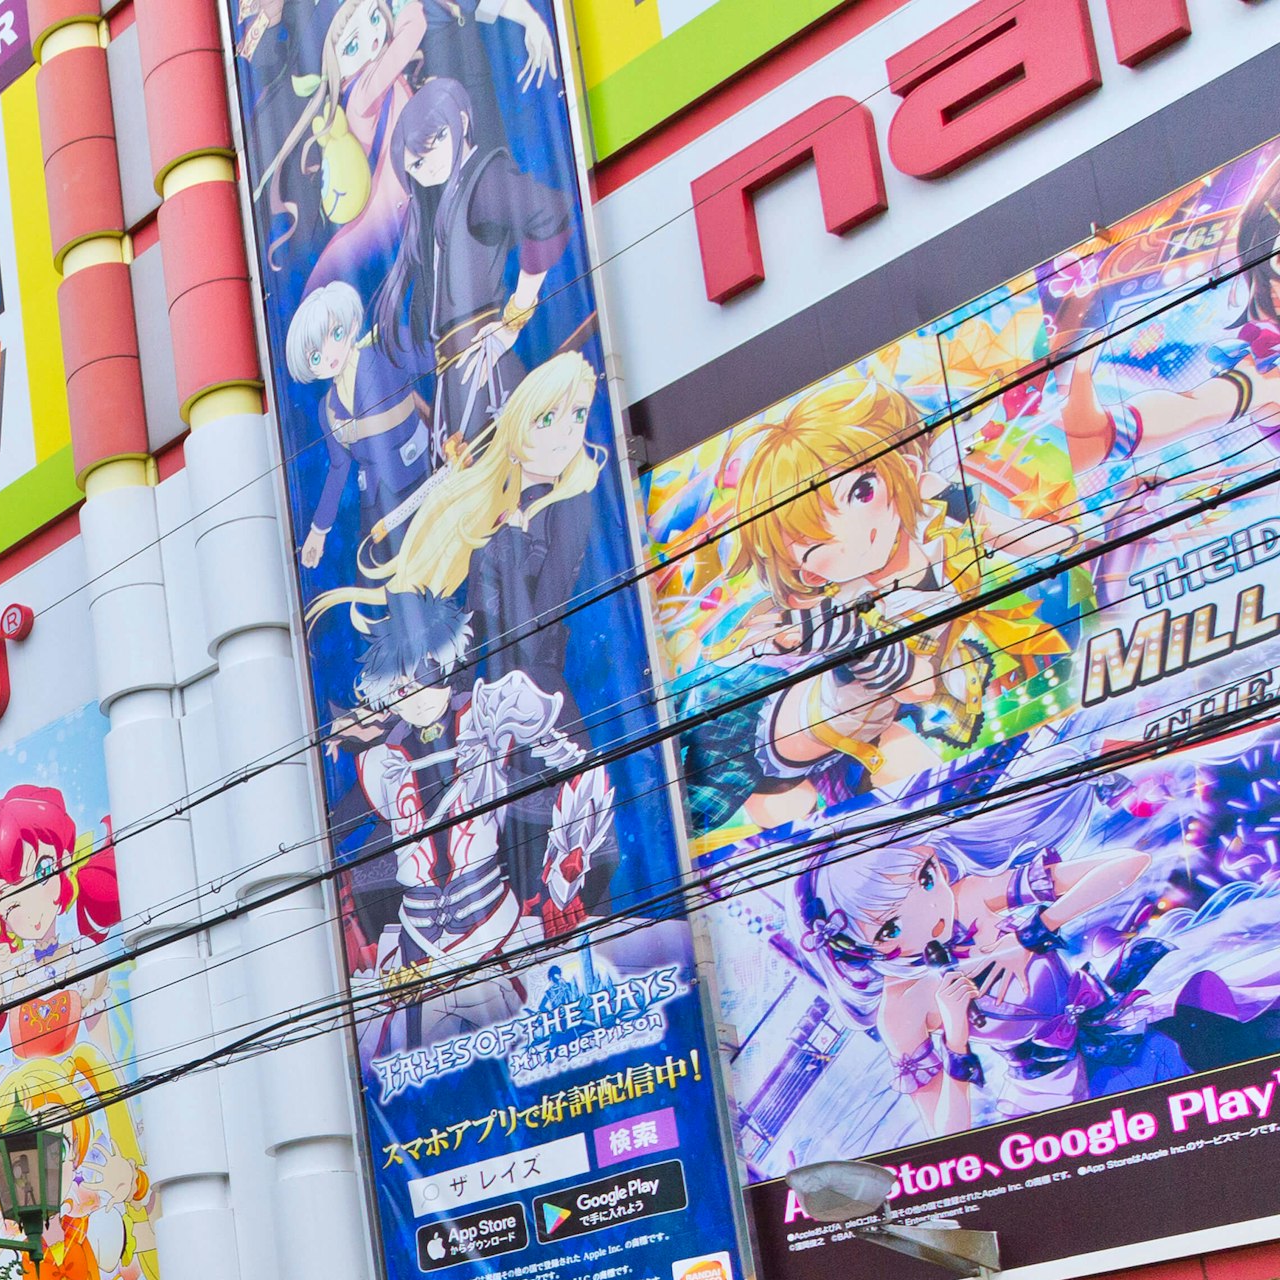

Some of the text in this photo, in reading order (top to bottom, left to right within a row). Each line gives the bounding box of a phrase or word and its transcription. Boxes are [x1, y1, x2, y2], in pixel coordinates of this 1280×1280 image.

[371, 1033, 472, 1099] TALES
[473, 1025, 519, 1059] OF
[520, 1001, 585, 1049] THE
[589, 967, 680, 1024] RAYS
[511, 1030, 593, 1076] Mirrage
[594, 1010, 663, 1048] Prison
[382, 1048, 702, 1169] スマホアプリで好評配信中!
[609, 1119, 659, 1157] 検索
[1001, 1107, 1158, 1171] Google
[576, 1177, 660, 1211] Google Play
[448, 1213, 517, 1246] App Store
[579, 1200, 645, 1227] で手に入れよう
[449, 1232, 517, 1257] からダウンロード
[583, 1247, 607, 1262] Apple
